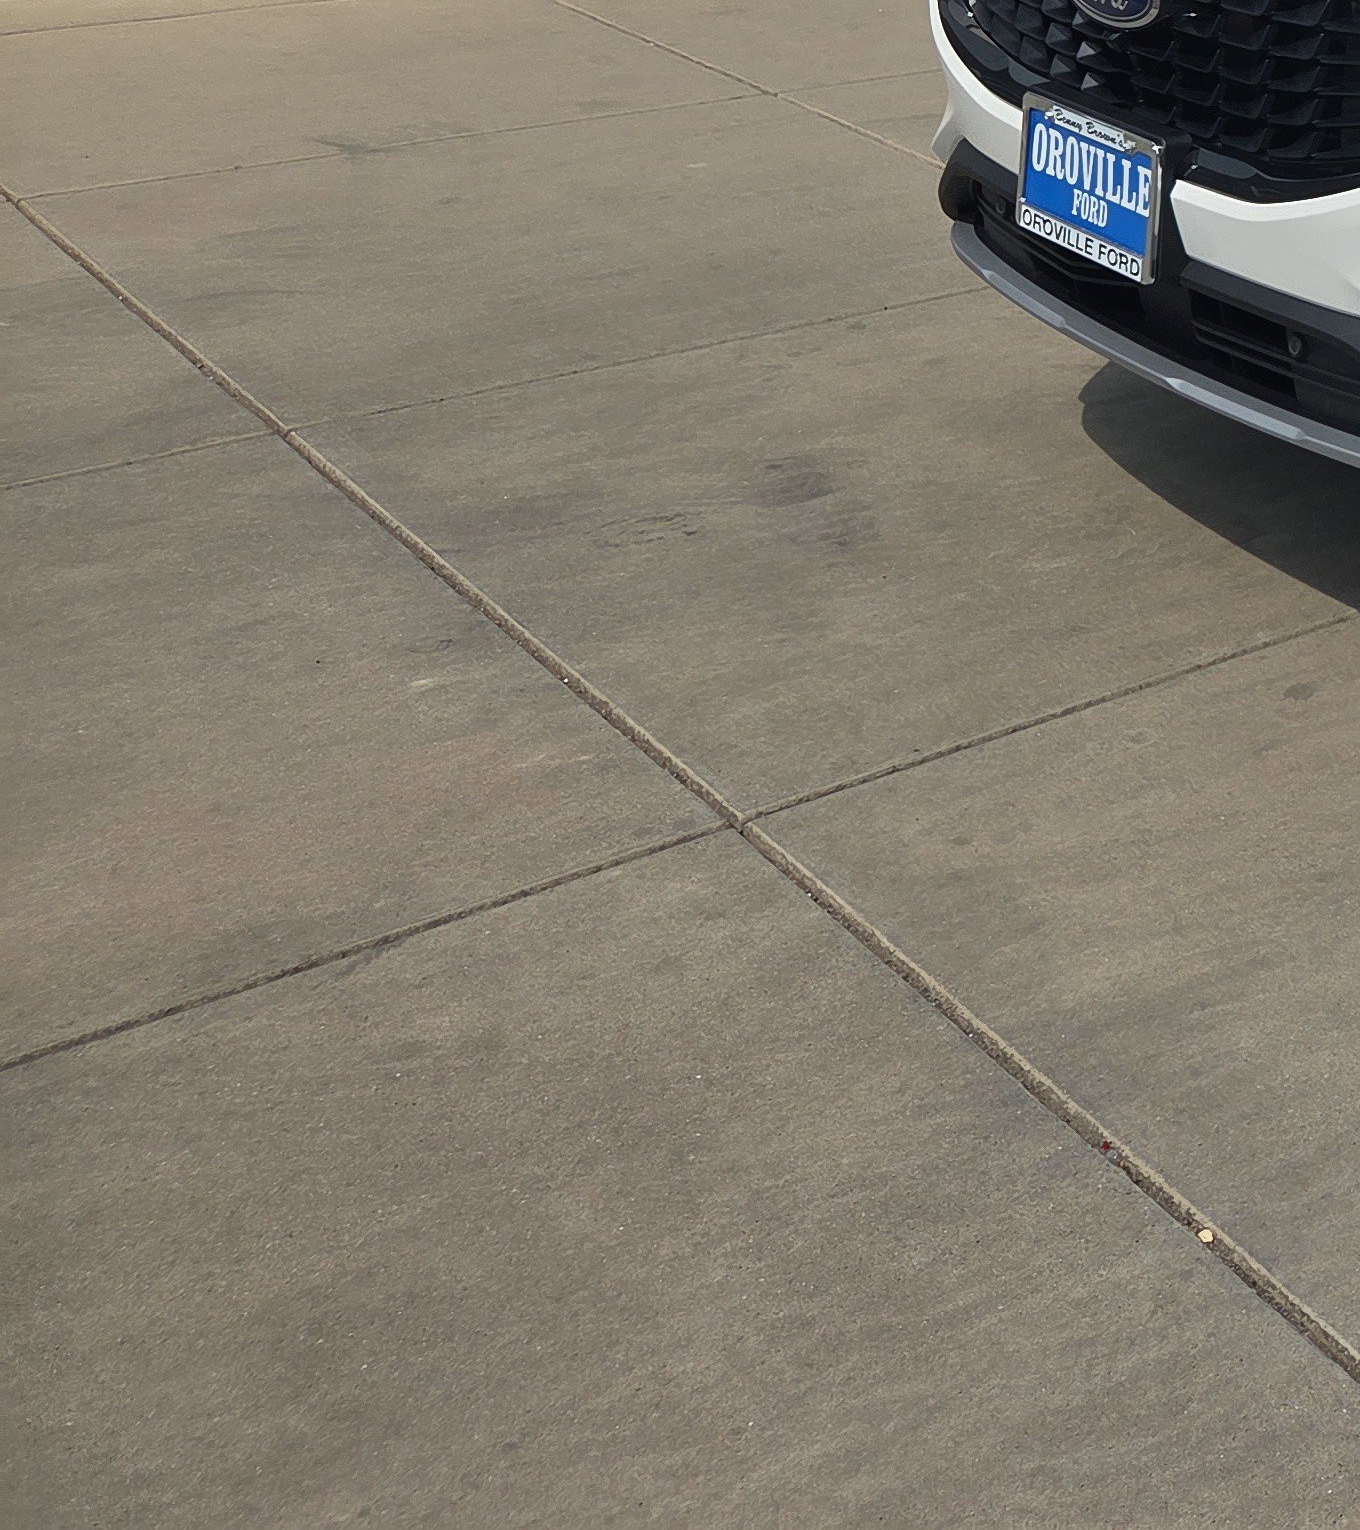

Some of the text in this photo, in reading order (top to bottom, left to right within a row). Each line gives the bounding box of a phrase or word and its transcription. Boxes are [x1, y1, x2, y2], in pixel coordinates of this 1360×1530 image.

[1085, 121, 1127, 149] Brown's
[1031, 123, 1152, 218] OROVILLE
[1072, 189, 1108, 228] FORD
[1022, 208, 1140, 278] OROVILLE FORD
